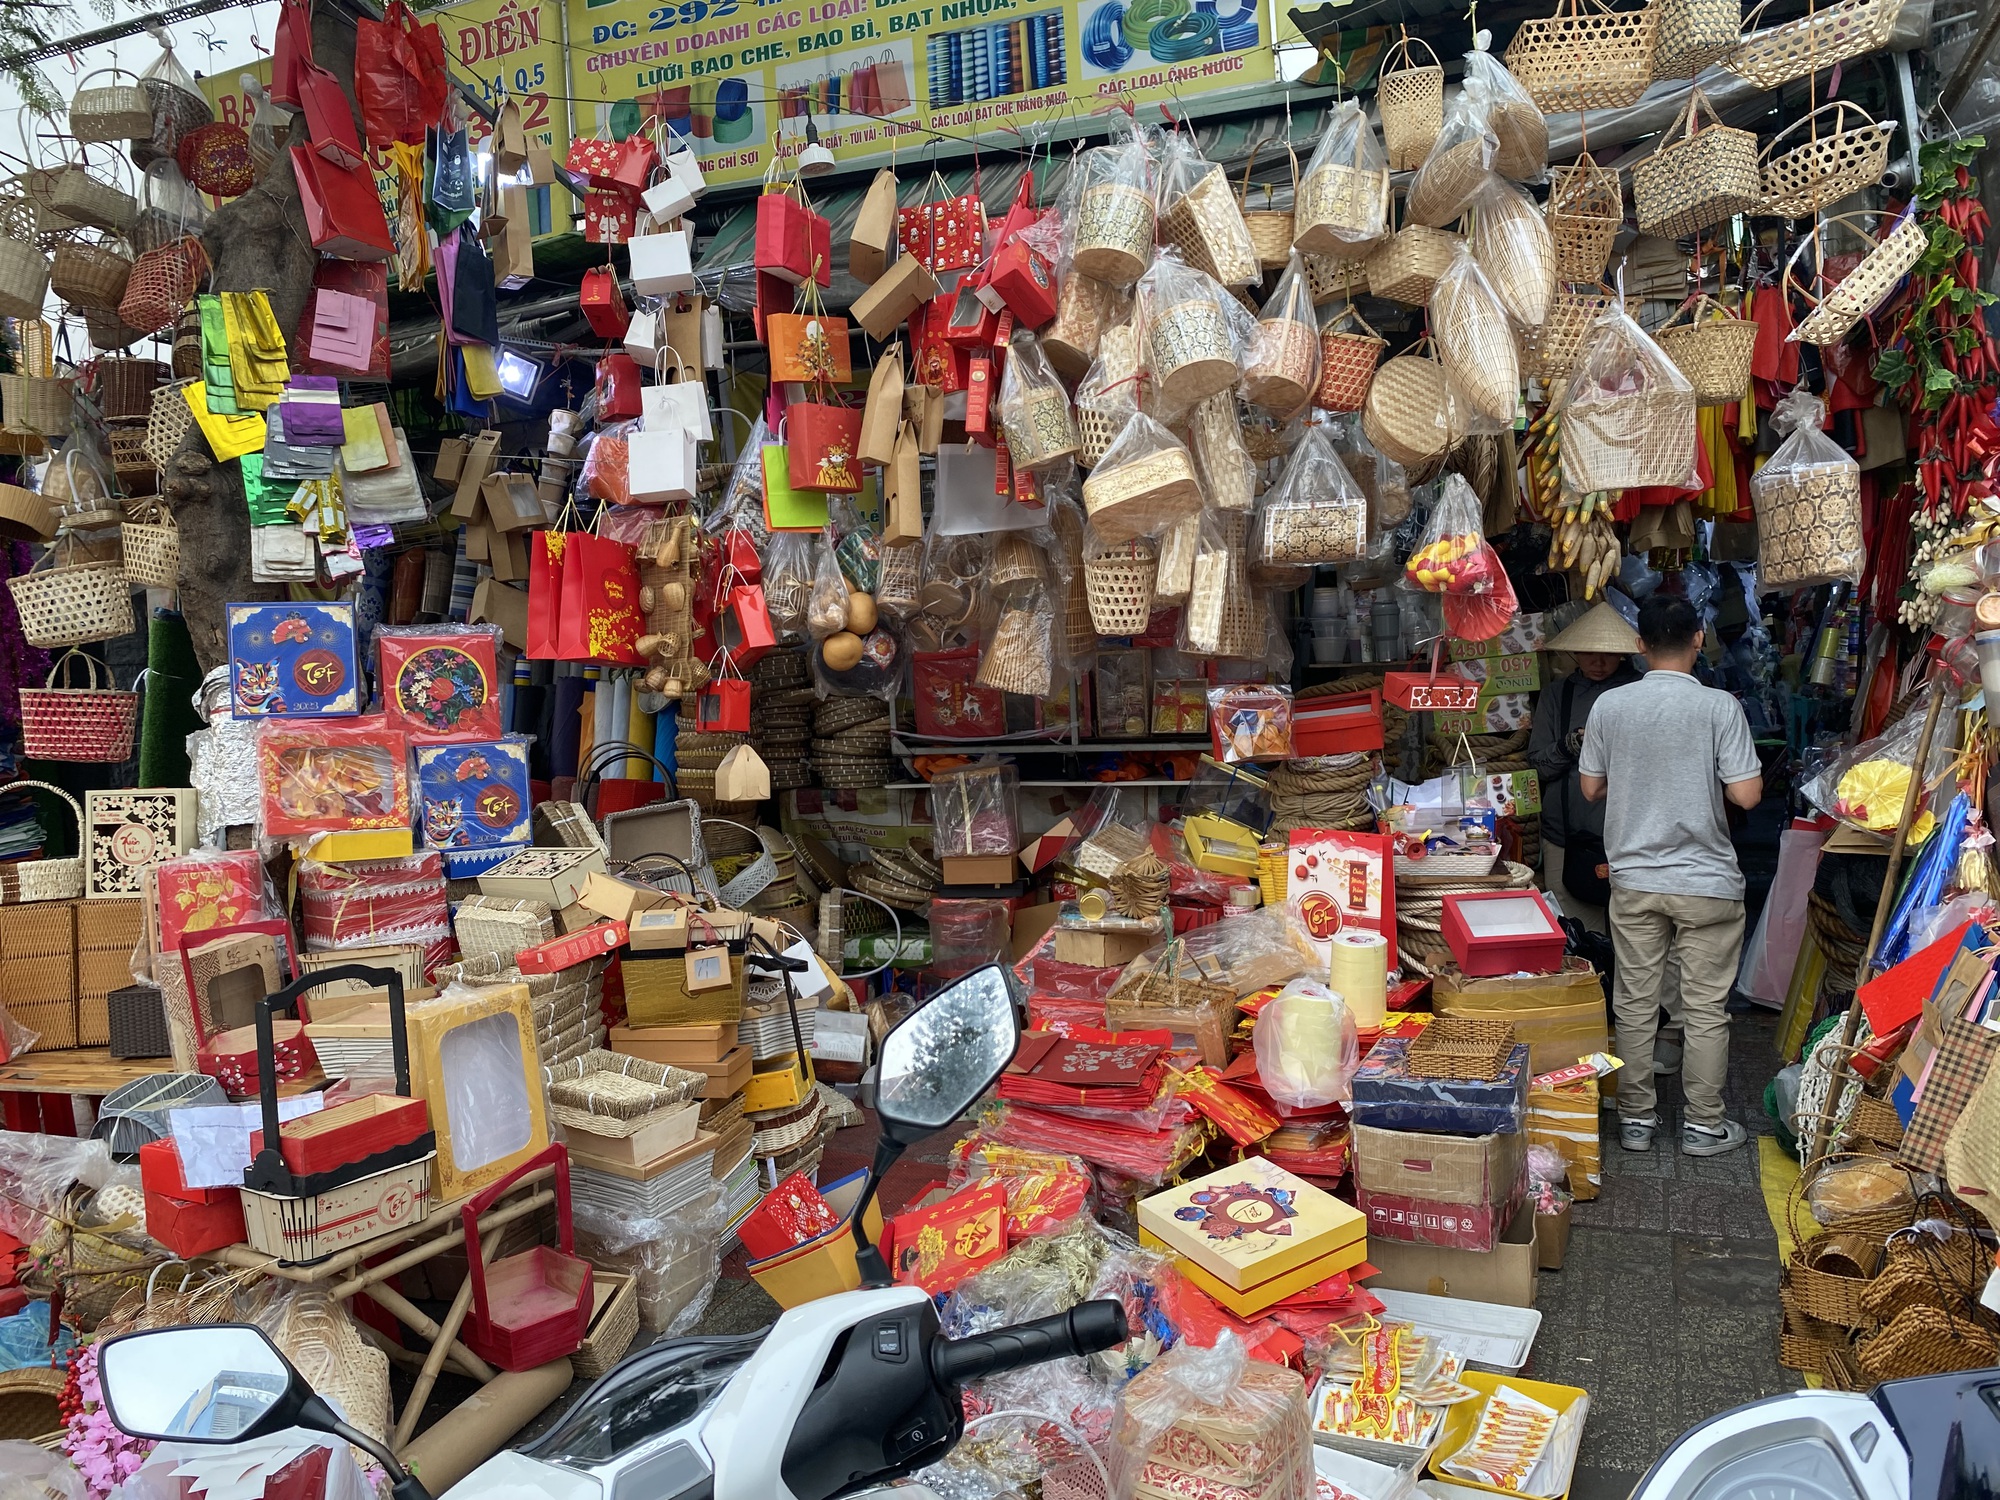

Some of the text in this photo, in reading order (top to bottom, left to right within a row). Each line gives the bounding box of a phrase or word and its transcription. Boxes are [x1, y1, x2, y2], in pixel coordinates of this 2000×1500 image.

[586, 0, 868, 73] CHUYÊN DOANH CÁC LOẠI:
[593, 0, 740, 44] ĐC: 292
[637, 63, 684, 88] LƯỚI
[690, 53, 733, 77] BAO
[741, 42, 791, 65] CHE,
[798, 28, 844, 54] BAO
[851, 18, 882, 42] BÌ,
[889, 8, 934, 33] BẠT
[515, 62, 545, 93] Q.5
[1098, 55, 1245, 94] CÁC LOẠI ỐNG NƯỚC
[467, 91, 550, 145] 32
[931, 112, 950, 129] CÁC
[952, 107, 973, 127] LOẠI
[975, 105, 993, 124] BẠT
[995, 101, 1014, 118] CHE
[1046, 91, 1068, 109] MƯA
[825, 132, 843, 150] GIẤY
[850, 129, 862, 145] TÚI
[863, 126, 877, 143] VẢI
[883, 121, 896, 139] TÚI
[898, 119, 922, 136] NILON
[718, 153, 737, 169] CHỈ
[740, 150, 759, 168] SỢI
[1455, 641, 1487, 657] 450
[1501, 656, 1532, 672] 450
[1495, 677, 1533, 690] RINGO
[1441, 718, 1472, 735] 450
[1529, 779, 1539, 804] 450
[1409, 1214, 1419, 1223] 10
